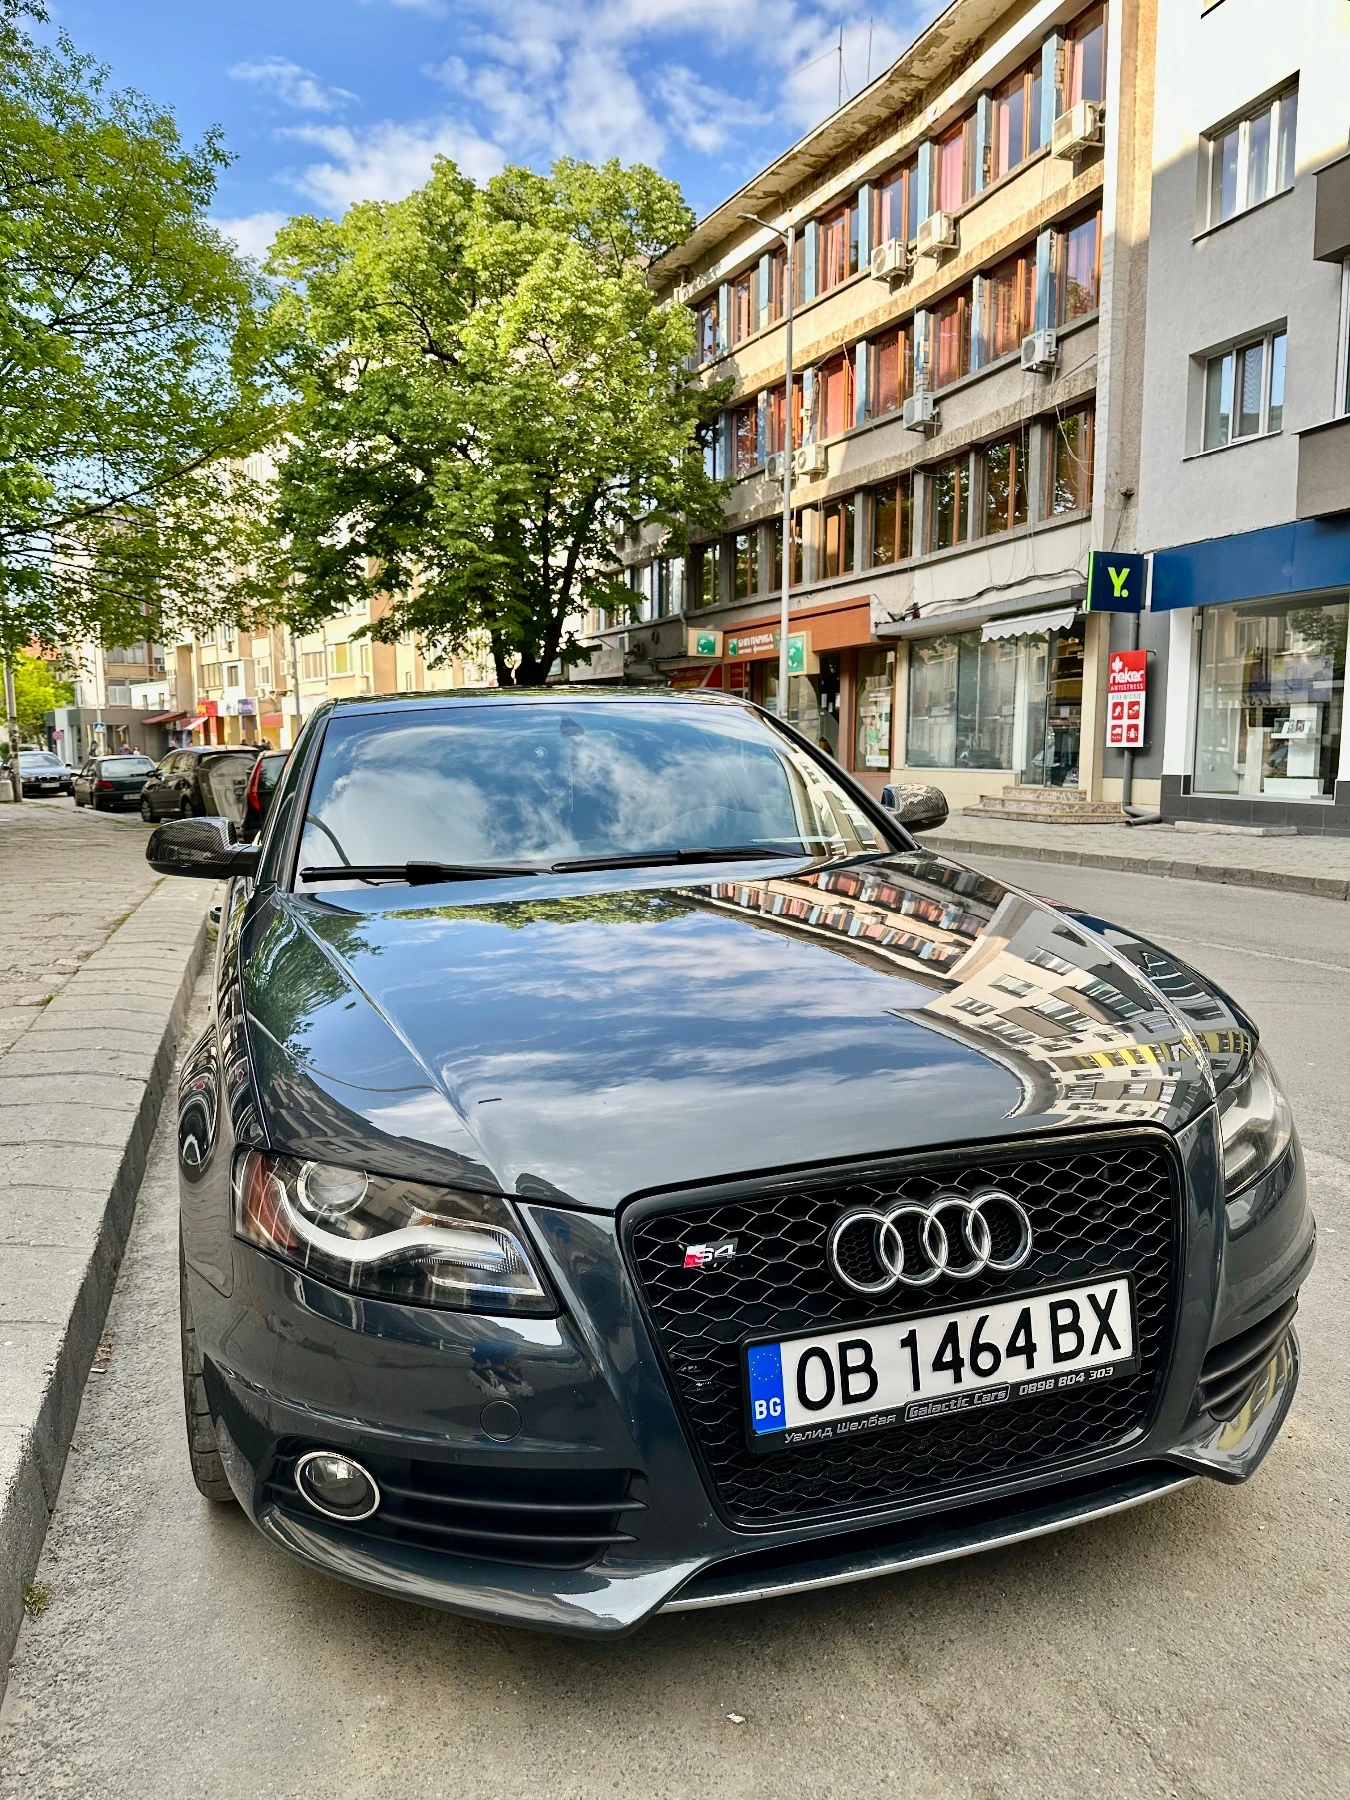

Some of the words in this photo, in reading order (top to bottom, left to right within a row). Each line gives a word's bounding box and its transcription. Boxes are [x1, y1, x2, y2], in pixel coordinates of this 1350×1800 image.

[1109, 667, 1145, 684] rieker
[1110, 682, 1144, 692] ANTISTRESS
[796, 1338, 879, 1411] OB
[900, 1306, 1037, 1392] 1464
[1049, 1288, 1122, 1364] BX
[1018, 1379, 1055, 1397] 0898
[1058, 1373, 1086, 1390] 804
[1088, 1366, 1114, 1382] 303
[755, 1397, 782, 1421] BG
[908, 1394, 969, 1418] Galactic
[972, 1388, 1007, 1407] Cars
[784, 1427, 833, 1444] Уалид
[836, 1414, 897, 1434] Шелбая
